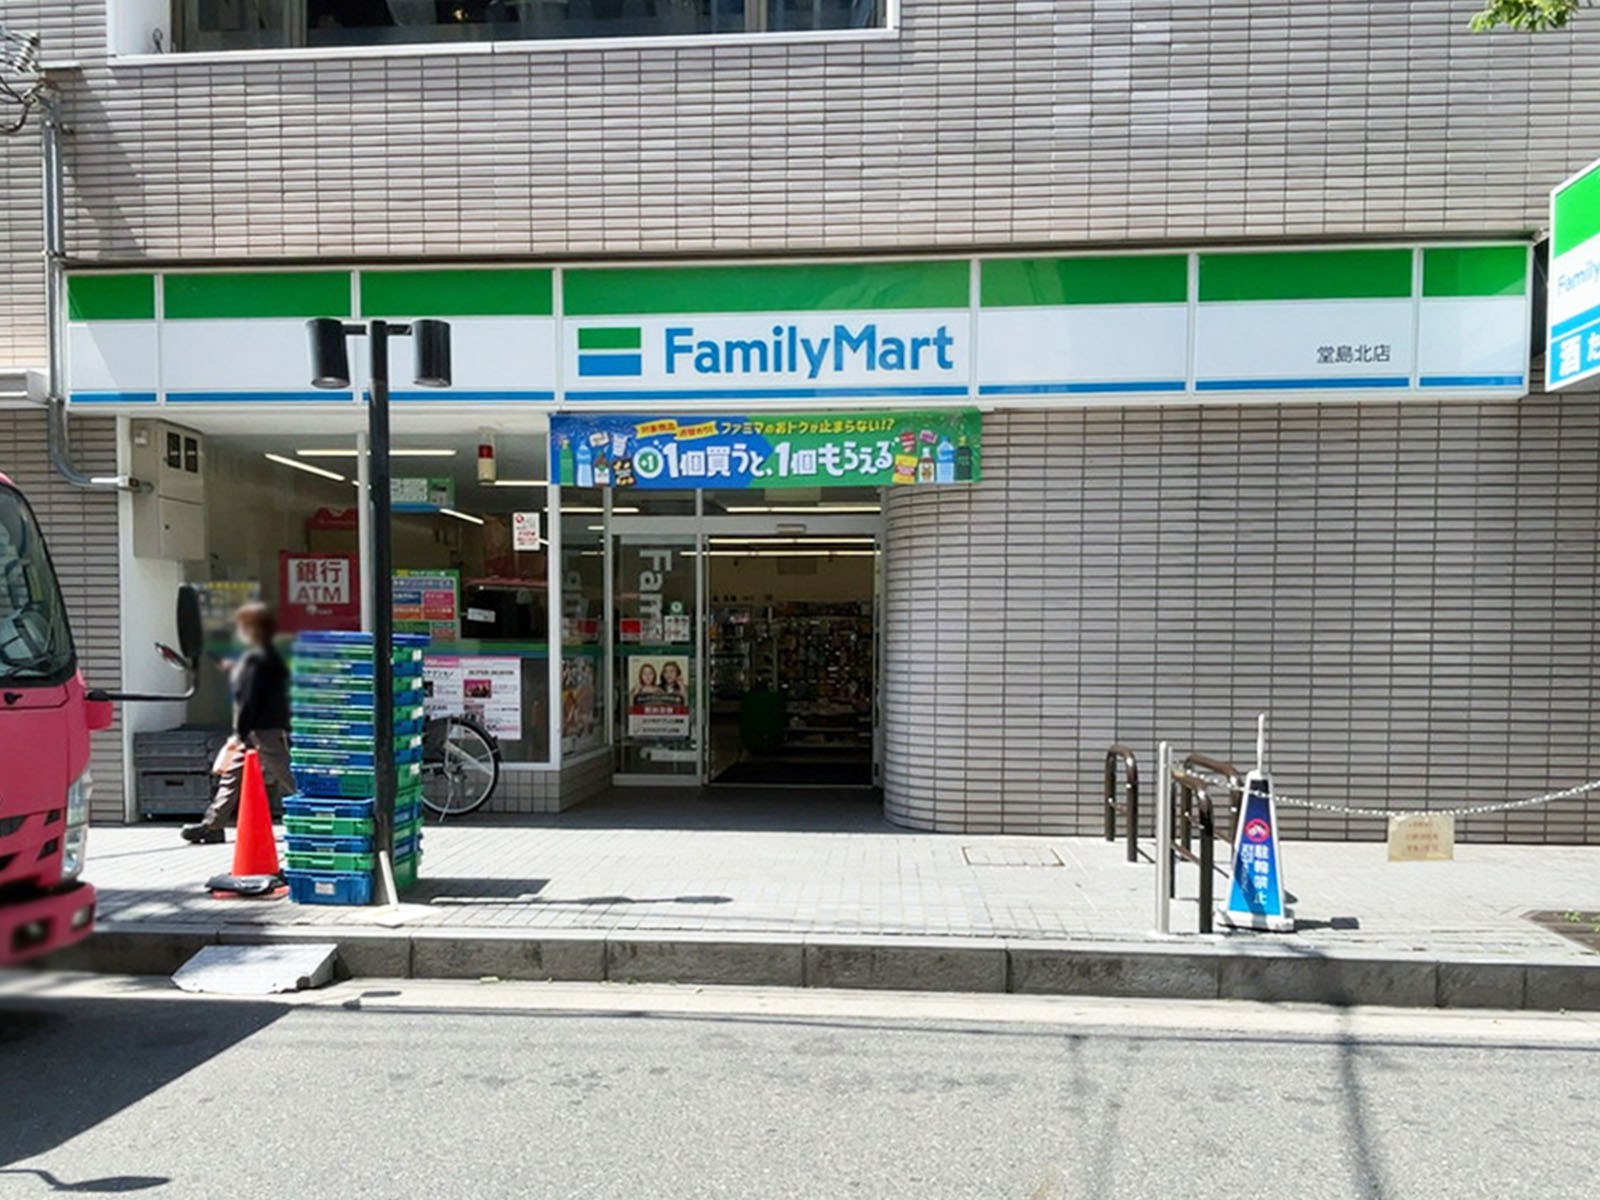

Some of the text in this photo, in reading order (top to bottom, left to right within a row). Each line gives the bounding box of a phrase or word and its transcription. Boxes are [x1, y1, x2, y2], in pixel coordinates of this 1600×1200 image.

[665, 324, 954, 379] FamilyMart
[1317, 344, 1390, 363] 堂島北店
[296, 560, 342, 584] 銀行
[296, 586, 342, 603] ATM
